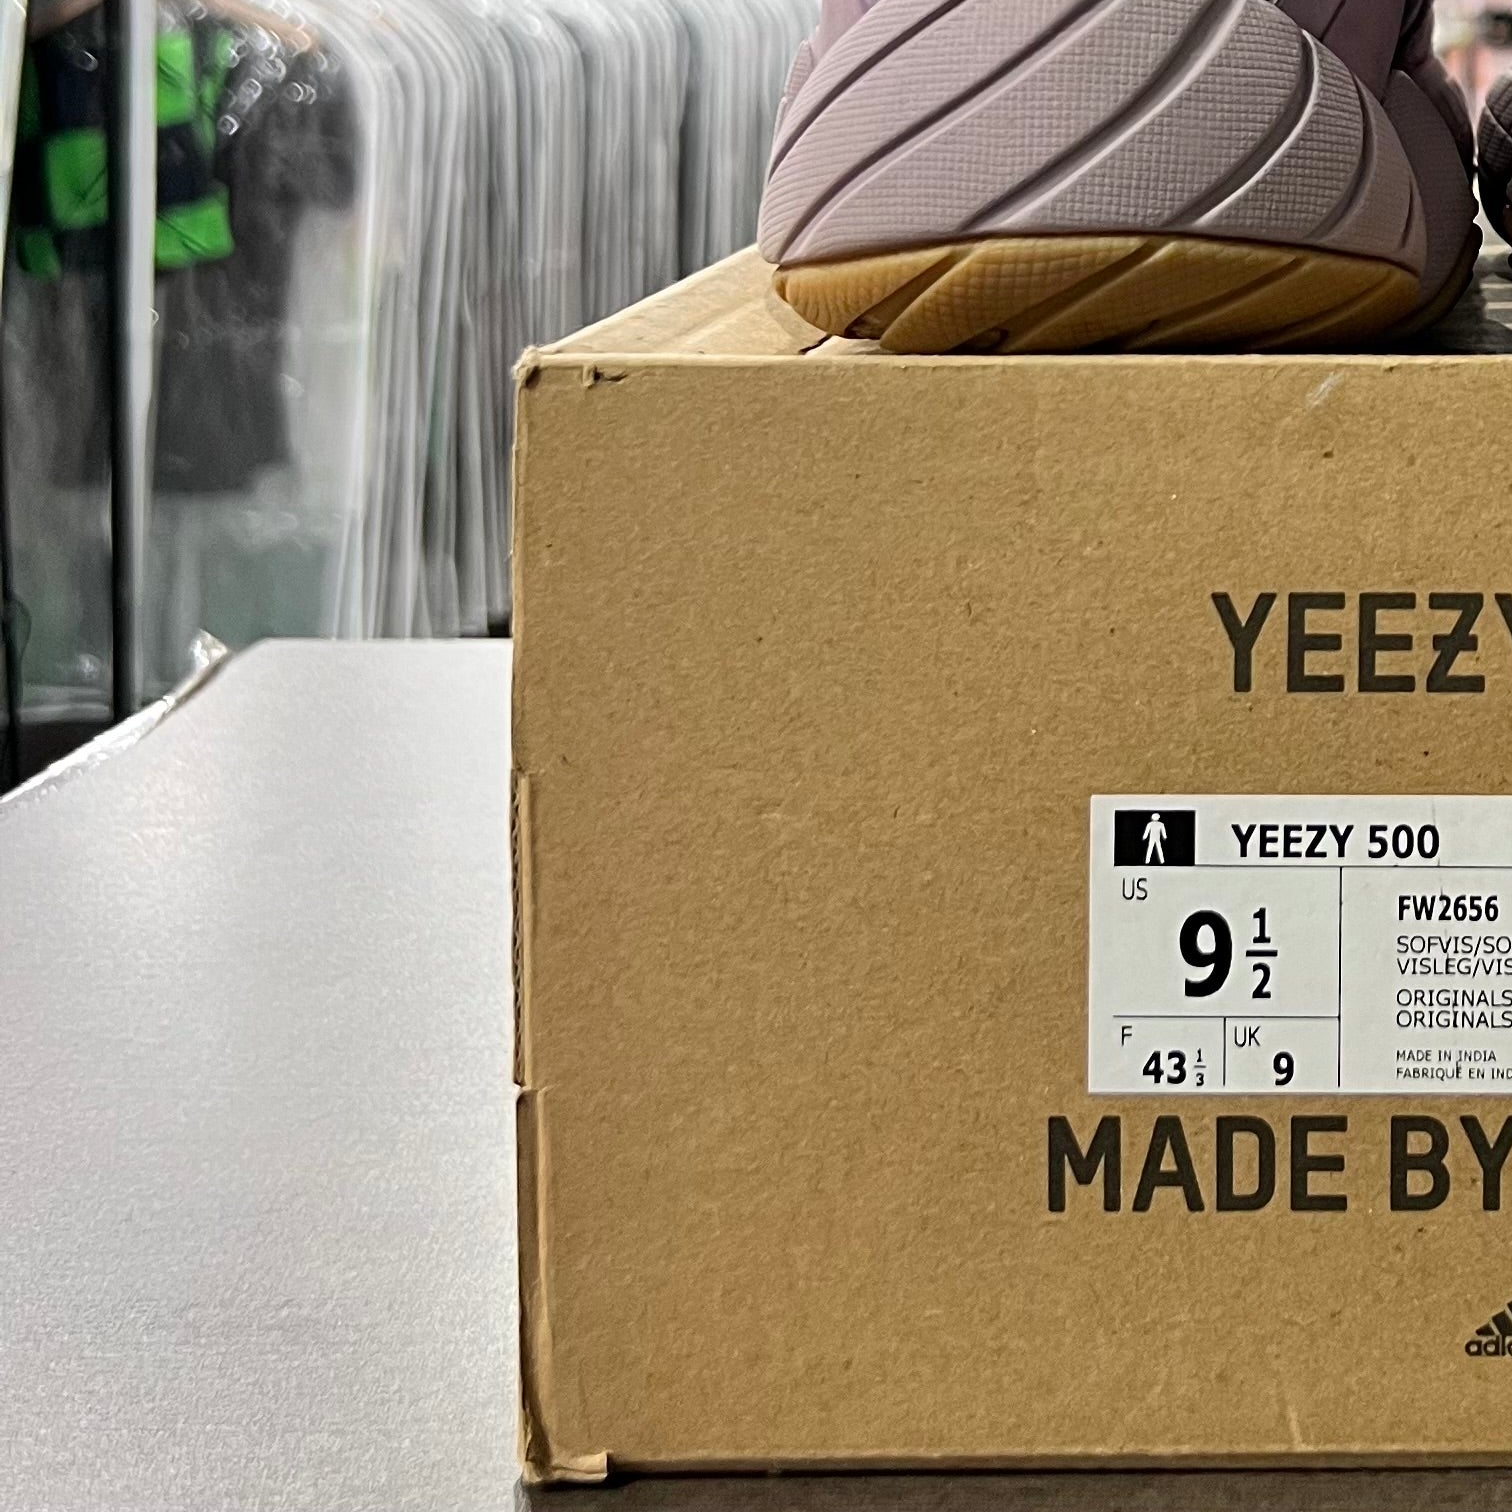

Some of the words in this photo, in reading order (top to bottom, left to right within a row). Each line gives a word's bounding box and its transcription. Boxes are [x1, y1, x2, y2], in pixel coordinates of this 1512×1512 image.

[1231, 823, 1354, 858] YEEZY
[1367, 823, 1440, 859] 500
[1121, 877, 1148, 901] US
[1398, 894, 1499, 922] FW2656
[1179, 909, 1233, 998] 9
[1121, 1025, 1133, 1047] F
[1234, 1025, 1261, 1048] UK
[1142, 1050, 1187, 1085] 43
[1272, 1051, 1295, 1086] 9
[1396, 1049, 1432, 1063] MADE
[1438, 1049, 1452, 1063] IN
[1457, 1049, 1497, 1063] INDIA
[1468, 1067, 1485, 1080] EN
[1047, 1114, 1348, 1213] MADE
